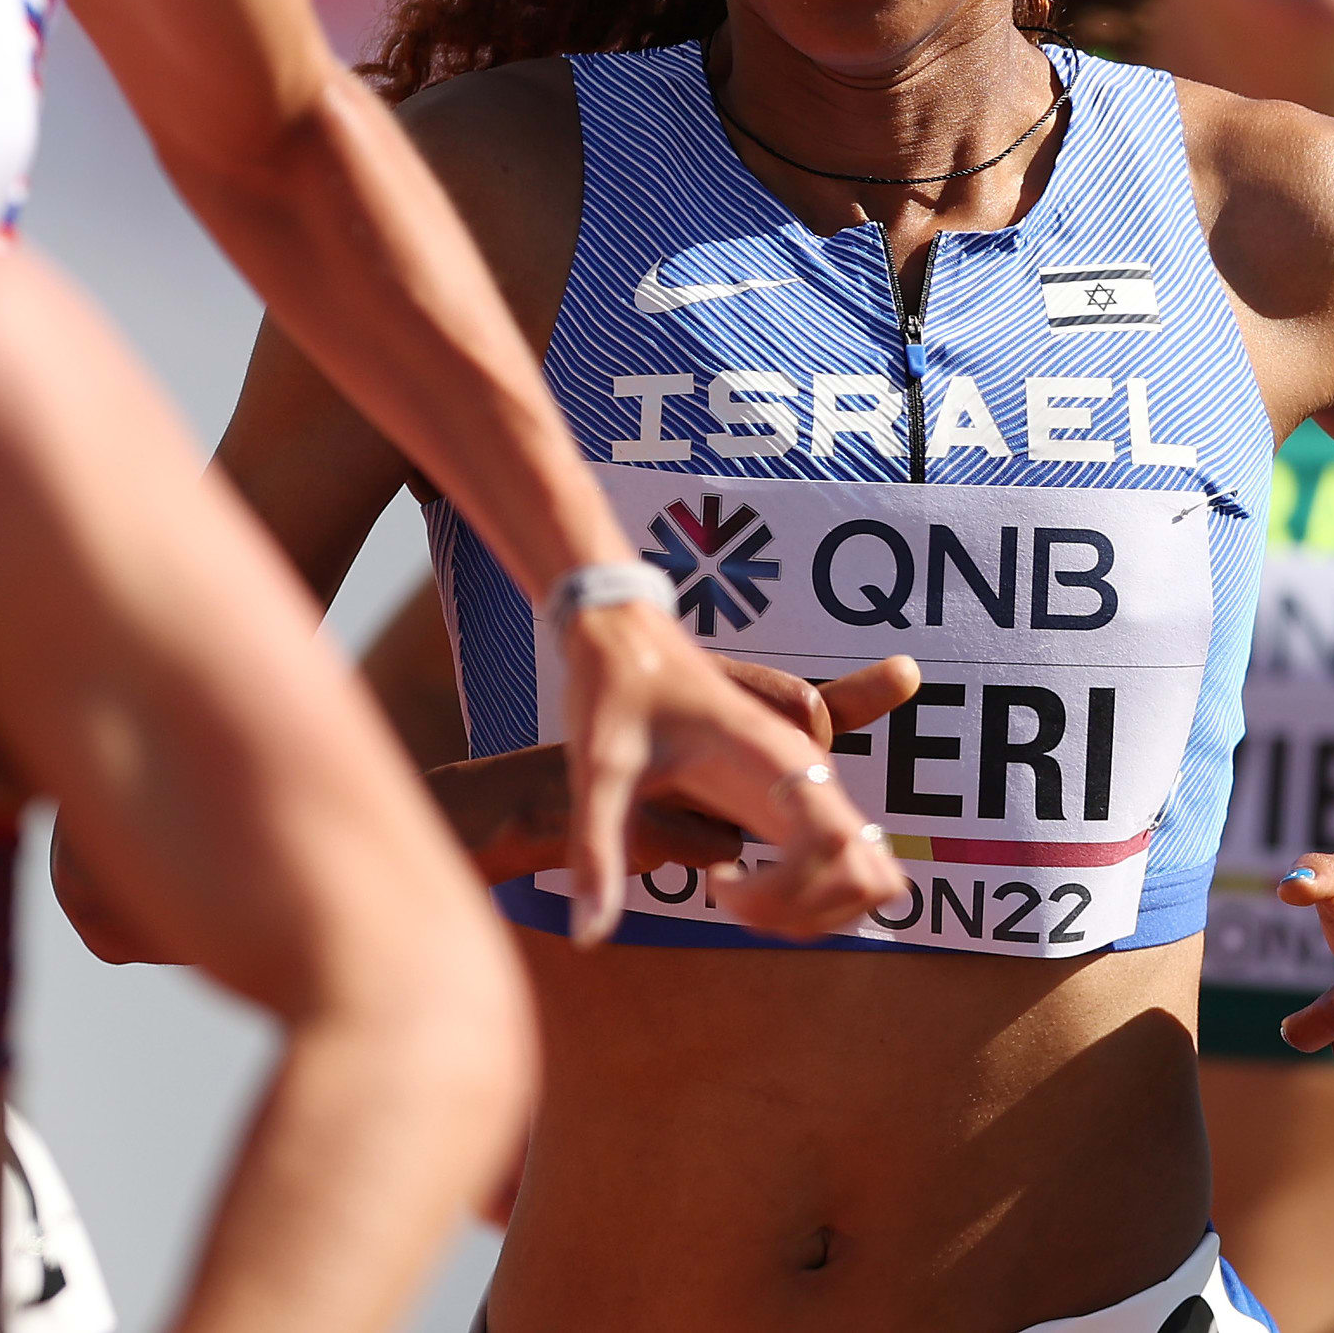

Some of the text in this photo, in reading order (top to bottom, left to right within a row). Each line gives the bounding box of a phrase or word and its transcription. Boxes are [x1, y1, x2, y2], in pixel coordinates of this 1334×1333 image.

[610, 370, 1198, 467] ISRAEL
[811, 519, 1120, 632] QNB
[802, 677, 1117, 821] ERI
